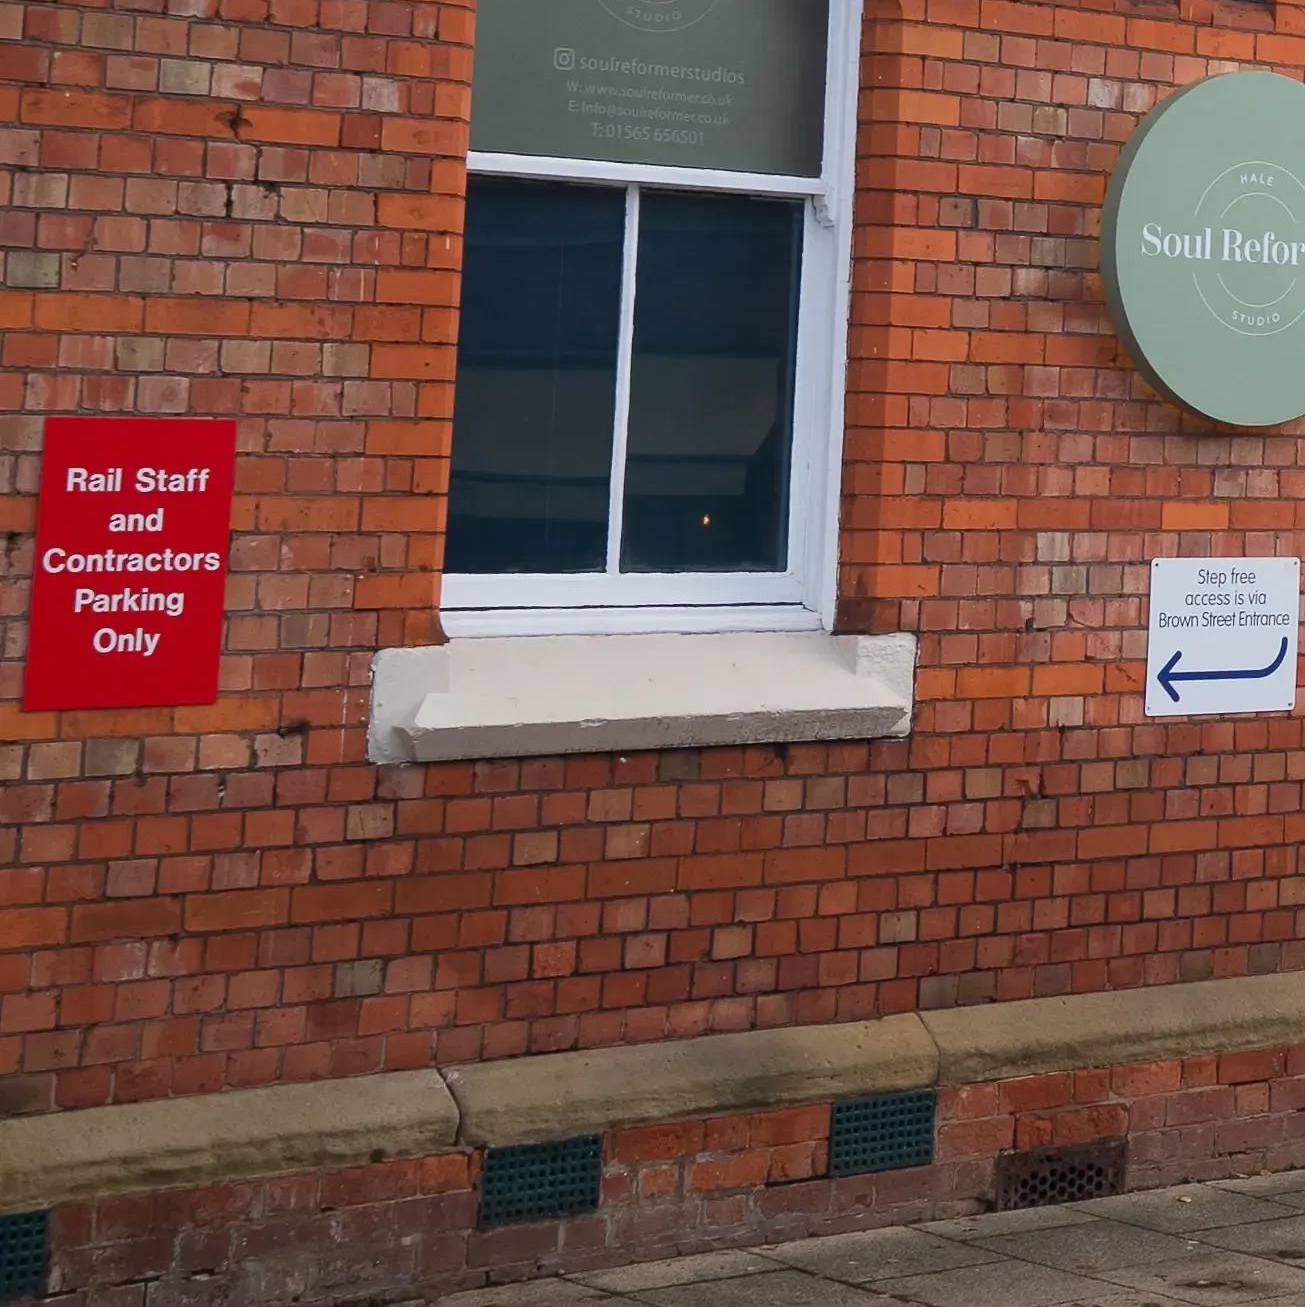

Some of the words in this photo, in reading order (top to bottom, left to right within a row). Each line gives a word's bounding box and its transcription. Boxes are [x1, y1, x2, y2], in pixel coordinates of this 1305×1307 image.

[626, 5, 683, 23] STUDIO
[579, 55, 745, 85] soulreformerstudios
[584, 83, 733, 107] www.soulreformer.co.uk
[653, 128, 705, 145] 656501
[1240, 173, 1275, 187] HALE
[1141, 223, 1213, 260] Soul
[1231, 310, 1281, 327] STUDIO
[66, 468, 123, 492] Rail
[135, 468, 210, 493] Staff
[108, 508, 164, 532] and
[42, 548, 220, 573] Contractors
[1198, 568, 1226, 588] Step
[1231, 568, 1256, 585] free
[74, 588, 185, 616] Parking
[1185, 593, 1230, 606] access
[1234, 590, 1245, 605] is
[1248, 590, 1267, 605] via
[1158, 613, 1199, 628] Brown
[1202, 612, 1236, 627] Street
[1239, 611, 1290, 627] Entrance
[93, 627, 161, 656] Only
